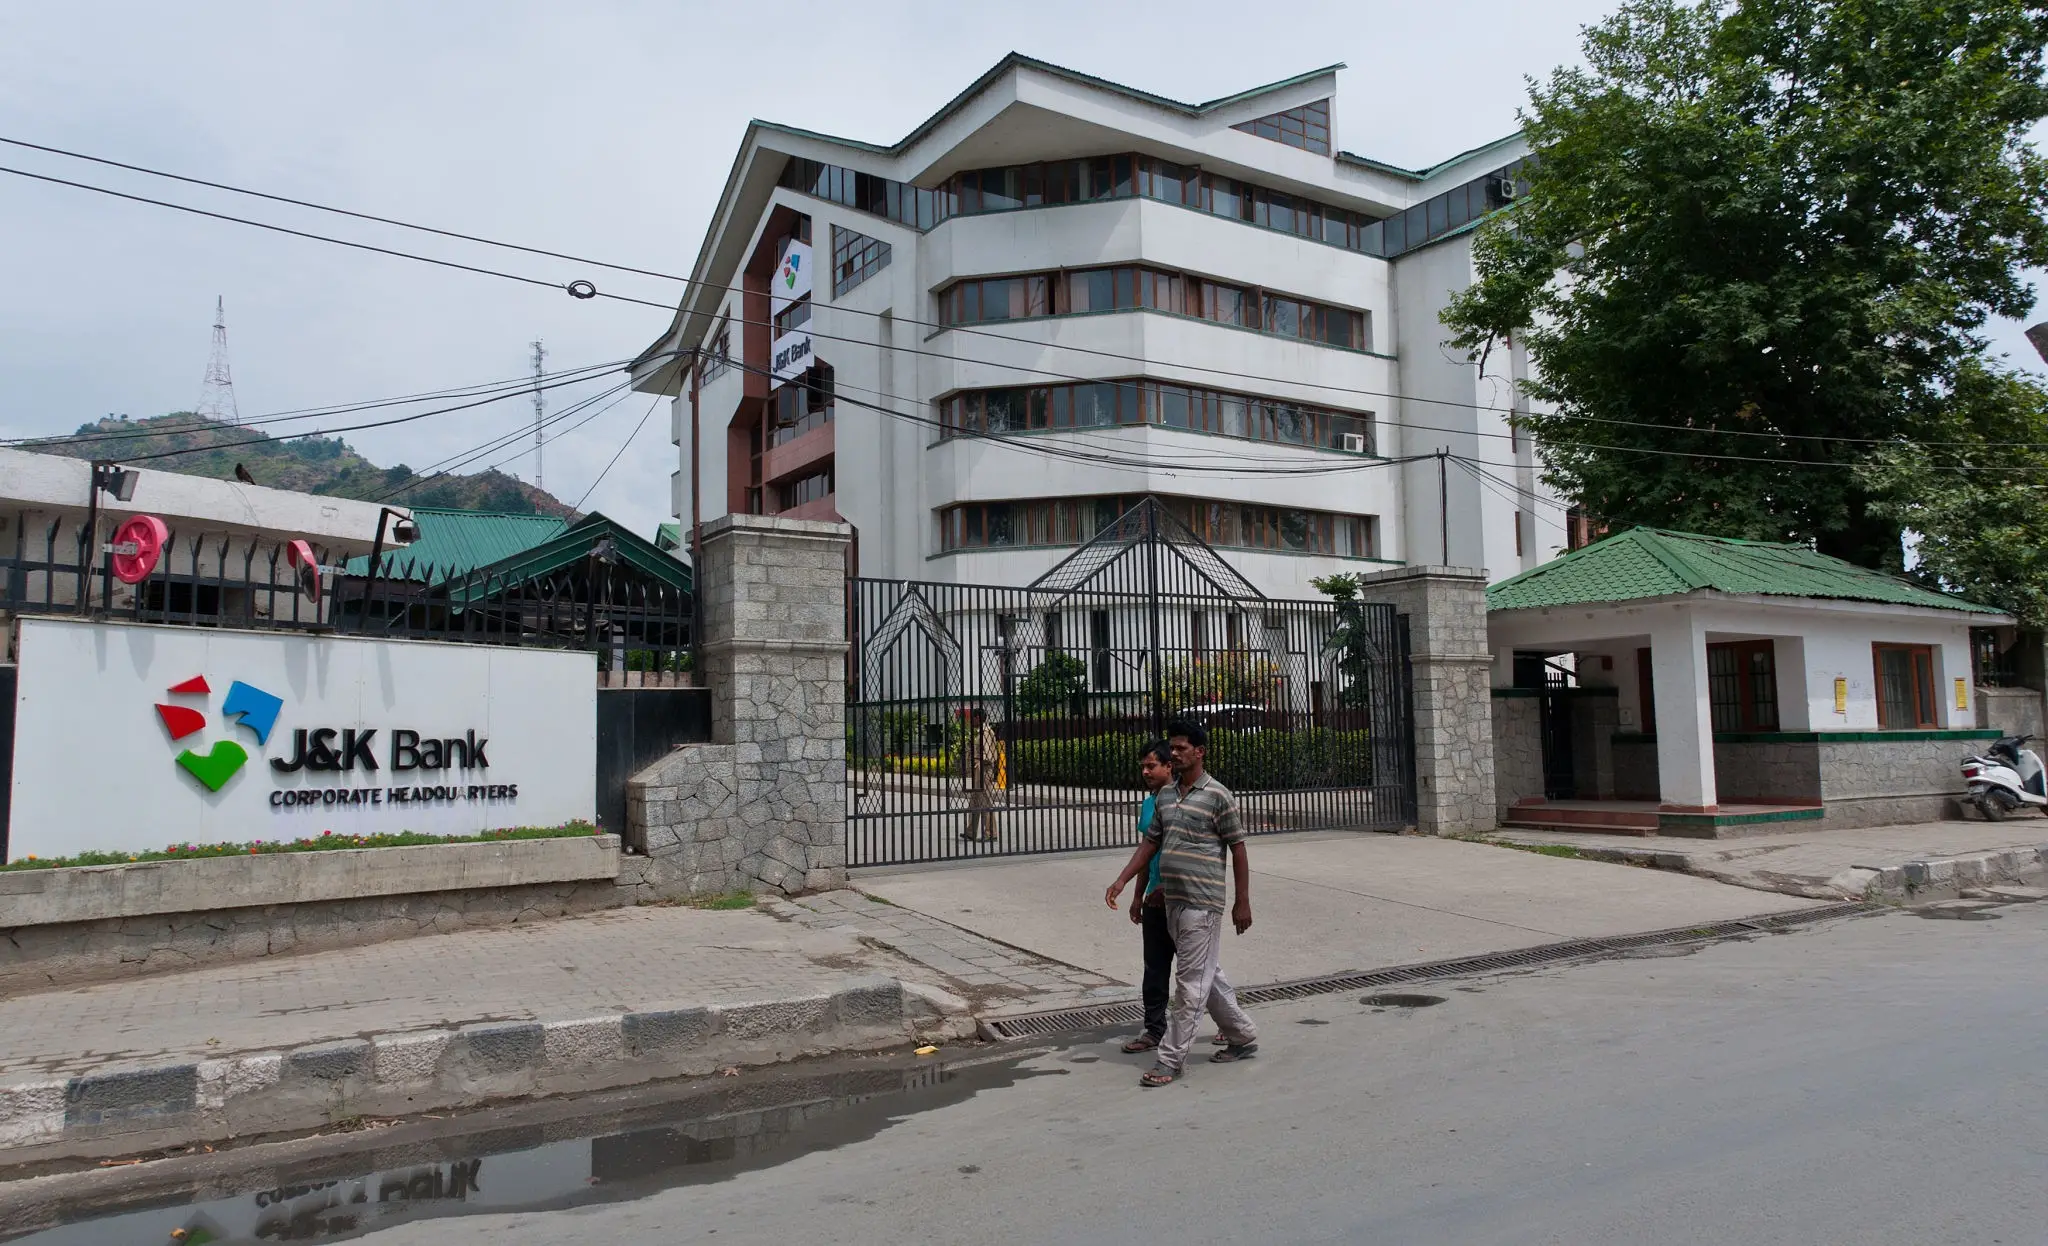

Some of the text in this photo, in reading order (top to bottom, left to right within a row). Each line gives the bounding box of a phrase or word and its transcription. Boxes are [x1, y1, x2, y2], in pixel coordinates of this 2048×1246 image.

[791, 336, 811, 362] Bank
[270, 728, 489, 772] J&K Bank
[269, 788, 382, 806] CORPORATE
